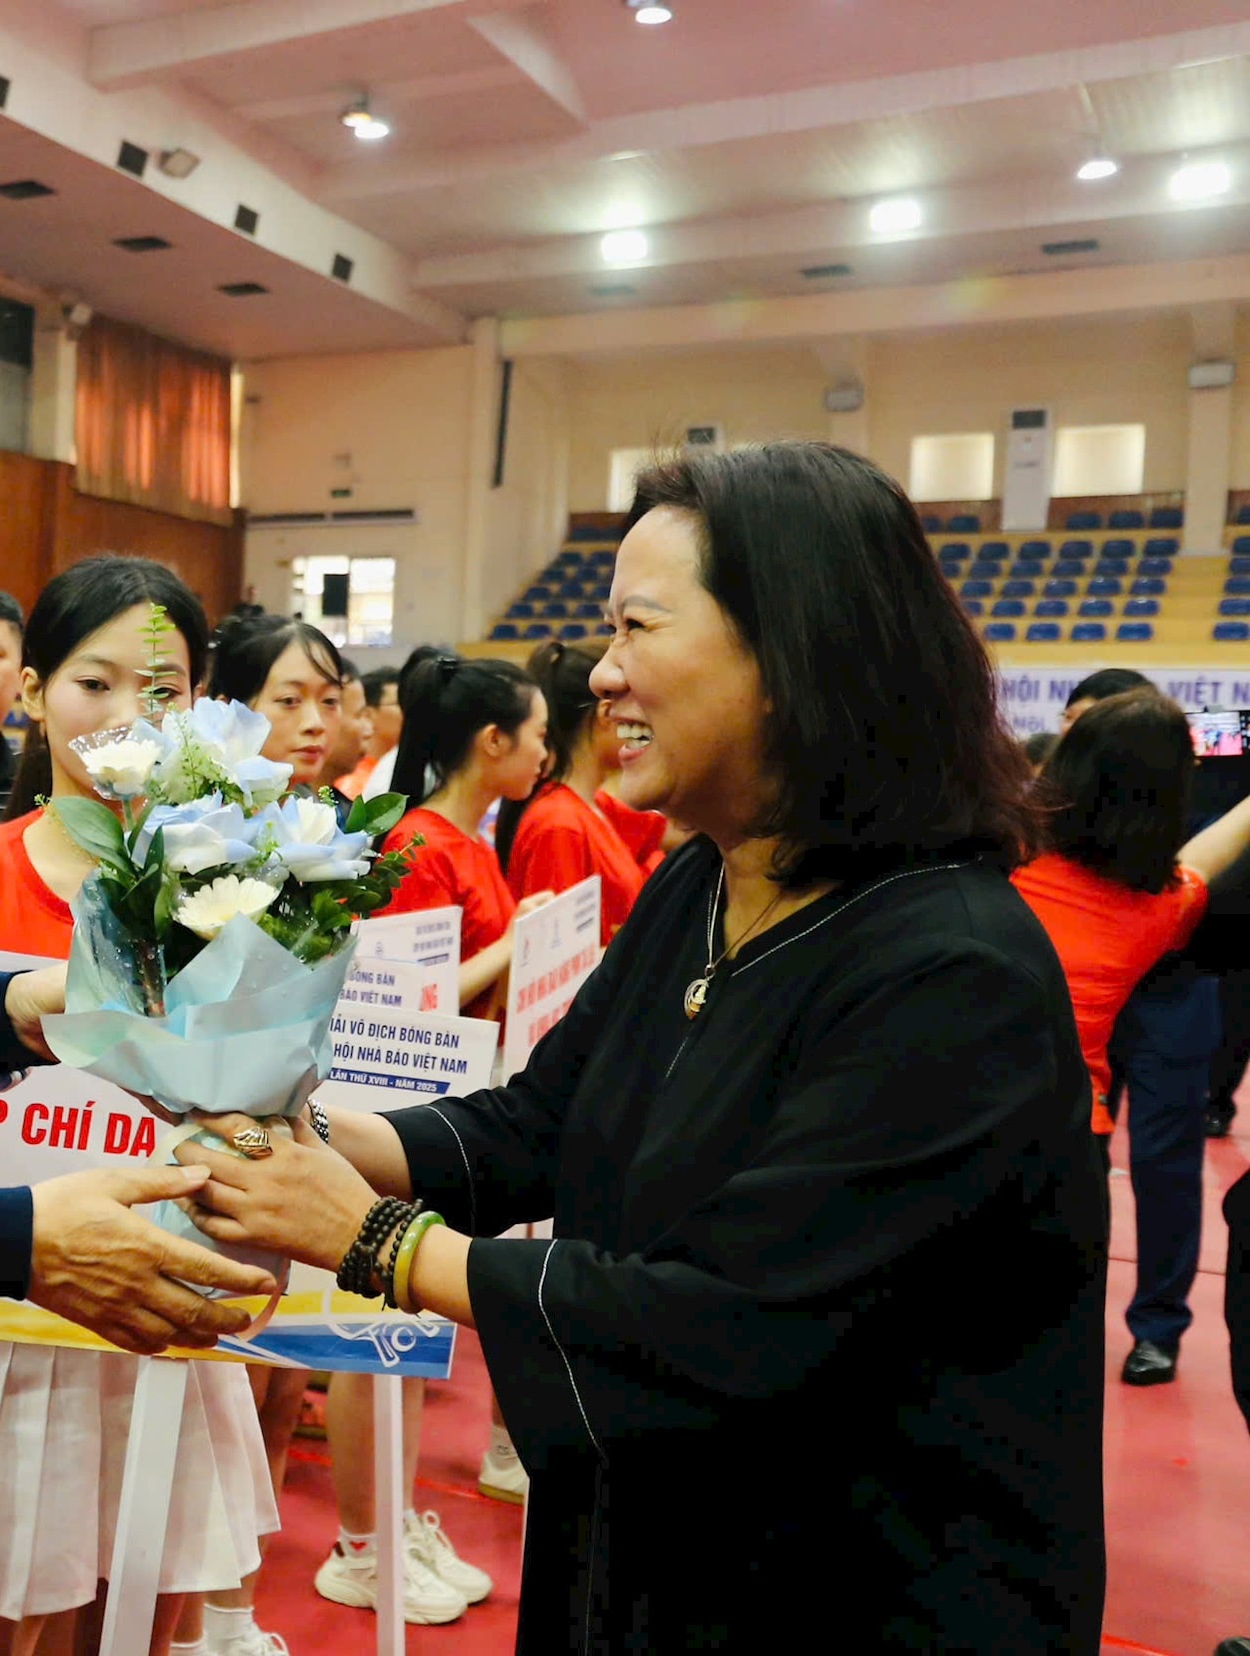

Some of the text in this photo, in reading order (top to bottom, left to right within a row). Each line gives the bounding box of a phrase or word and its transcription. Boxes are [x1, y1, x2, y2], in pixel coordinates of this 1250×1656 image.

[330, 1013, 460, 1049] IẢI VÔ ĐỊCH BÓNG BÀN
[334, 1041, 468, 1075] HỘI NHÀ BÁO VIỆT NAM
[416, 1082, 437, 1092] 2025
[21, 1100, 97, 1151] CHÍ
